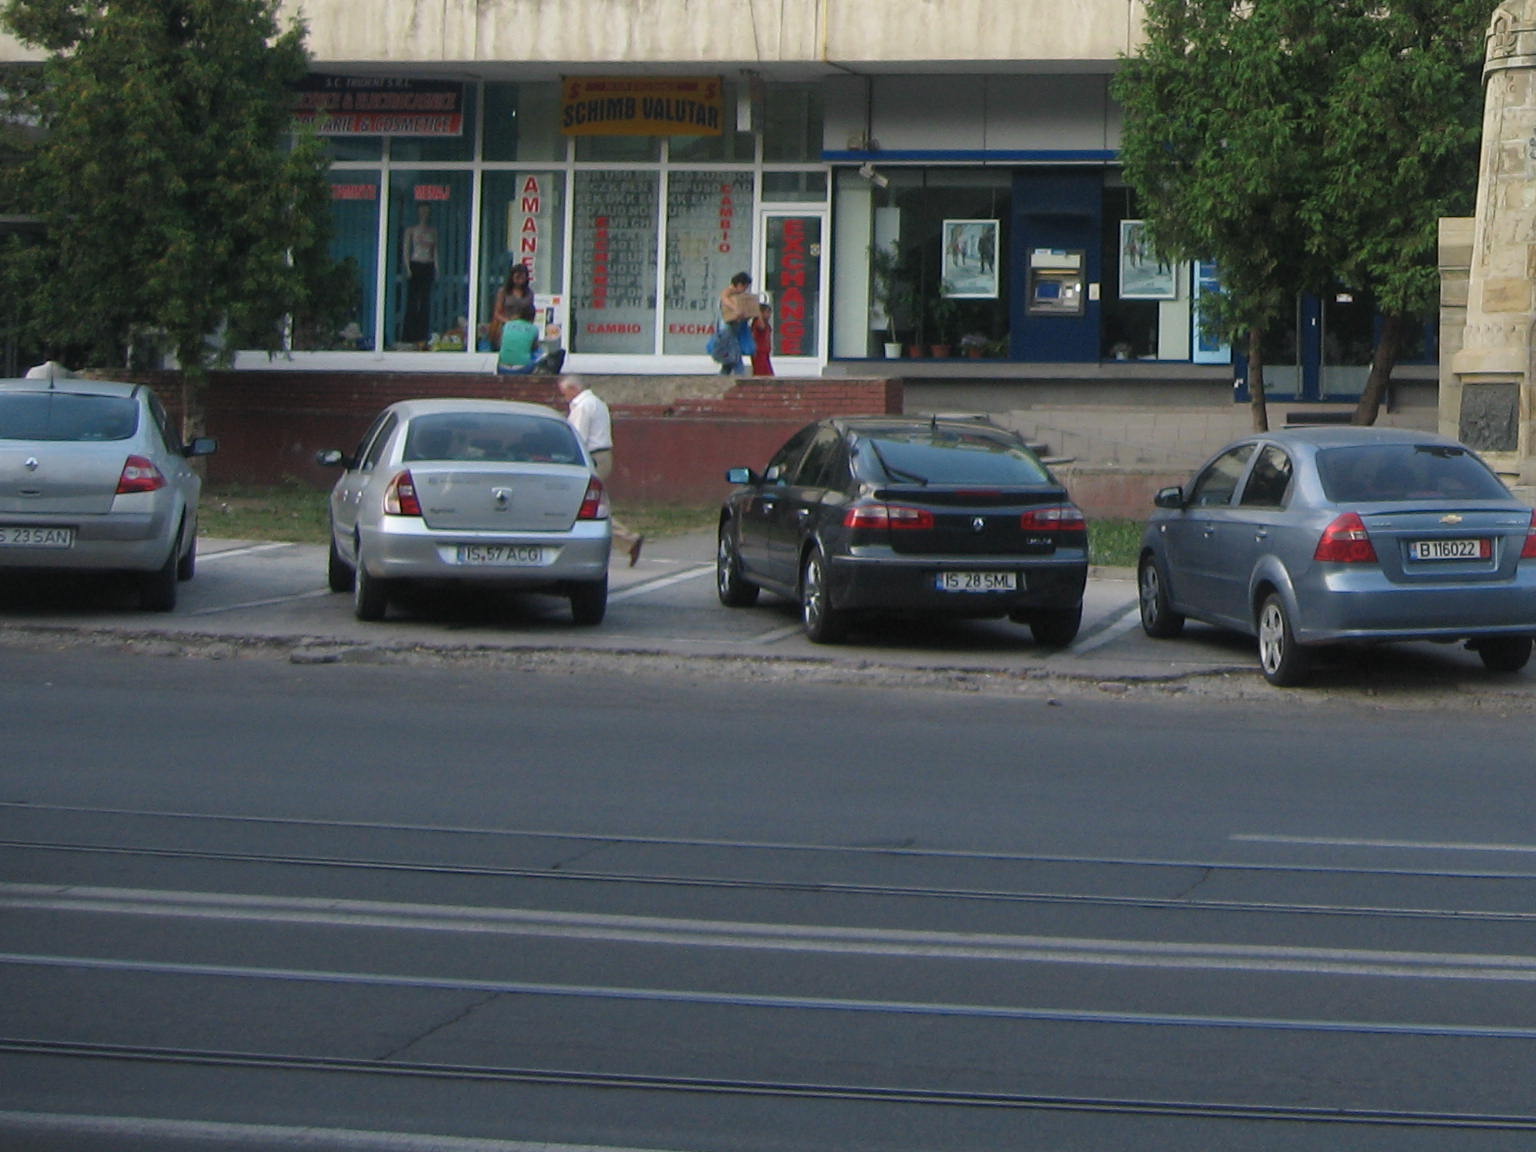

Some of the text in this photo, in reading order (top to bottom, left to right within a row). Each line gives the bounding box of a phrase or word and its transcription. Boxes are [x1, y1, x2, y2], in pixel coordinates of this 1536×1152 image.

[563, 97, 719, 129] SCHIMB VALUTAR
[520, 176, 540, 282] AMANE
[587, 323, 641, 335] CAMBIO
[669, 323, 716, 335] EXCHA
[1420, 542, 1475, 558] B 116022
[945, 572, 1014, 588] IS 28 SML
